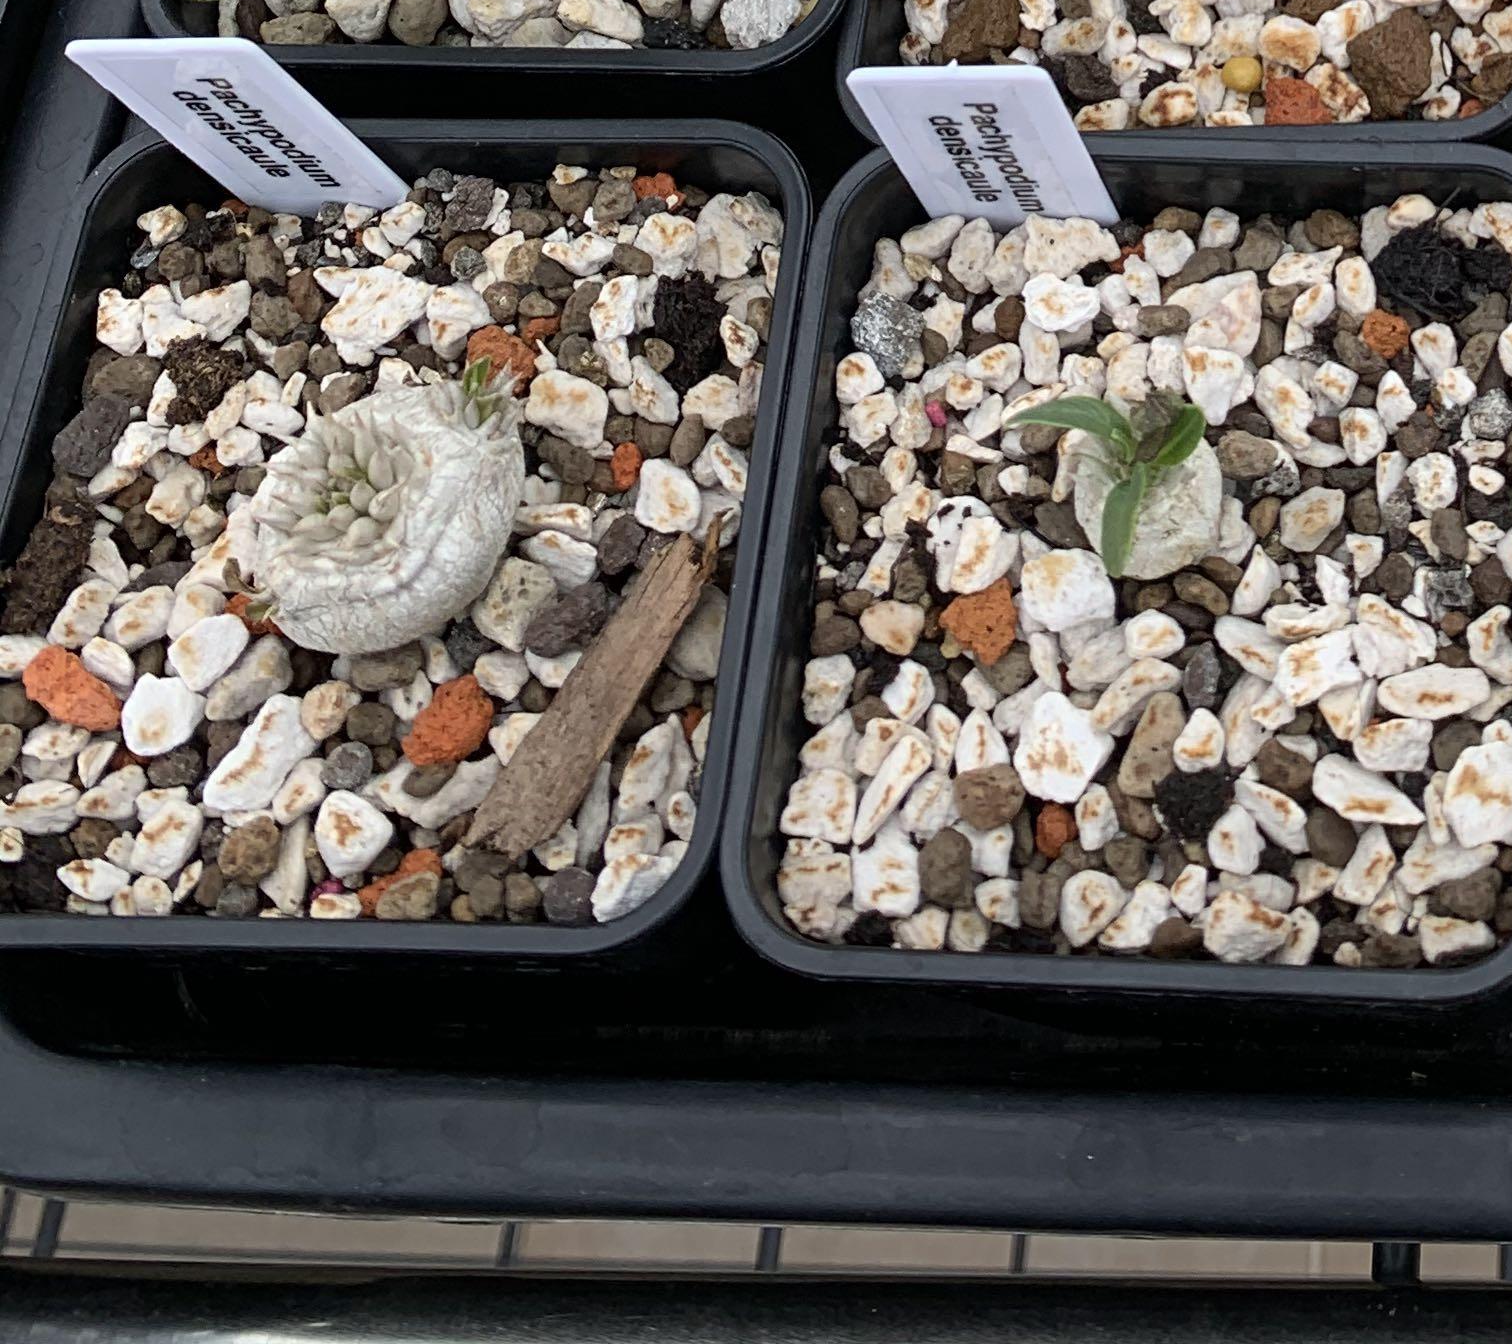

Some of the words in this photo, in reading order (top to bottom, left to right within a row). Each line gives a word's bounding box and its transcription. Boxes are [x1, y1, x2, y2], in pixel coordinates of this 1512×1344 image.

[172, 91, 290, 178] densicaule
[195, 78, 341, 187] Pachypodium
[928, 116, 1002, 202] densicaule
[963, 103, 1044, 212] Pachypodium
